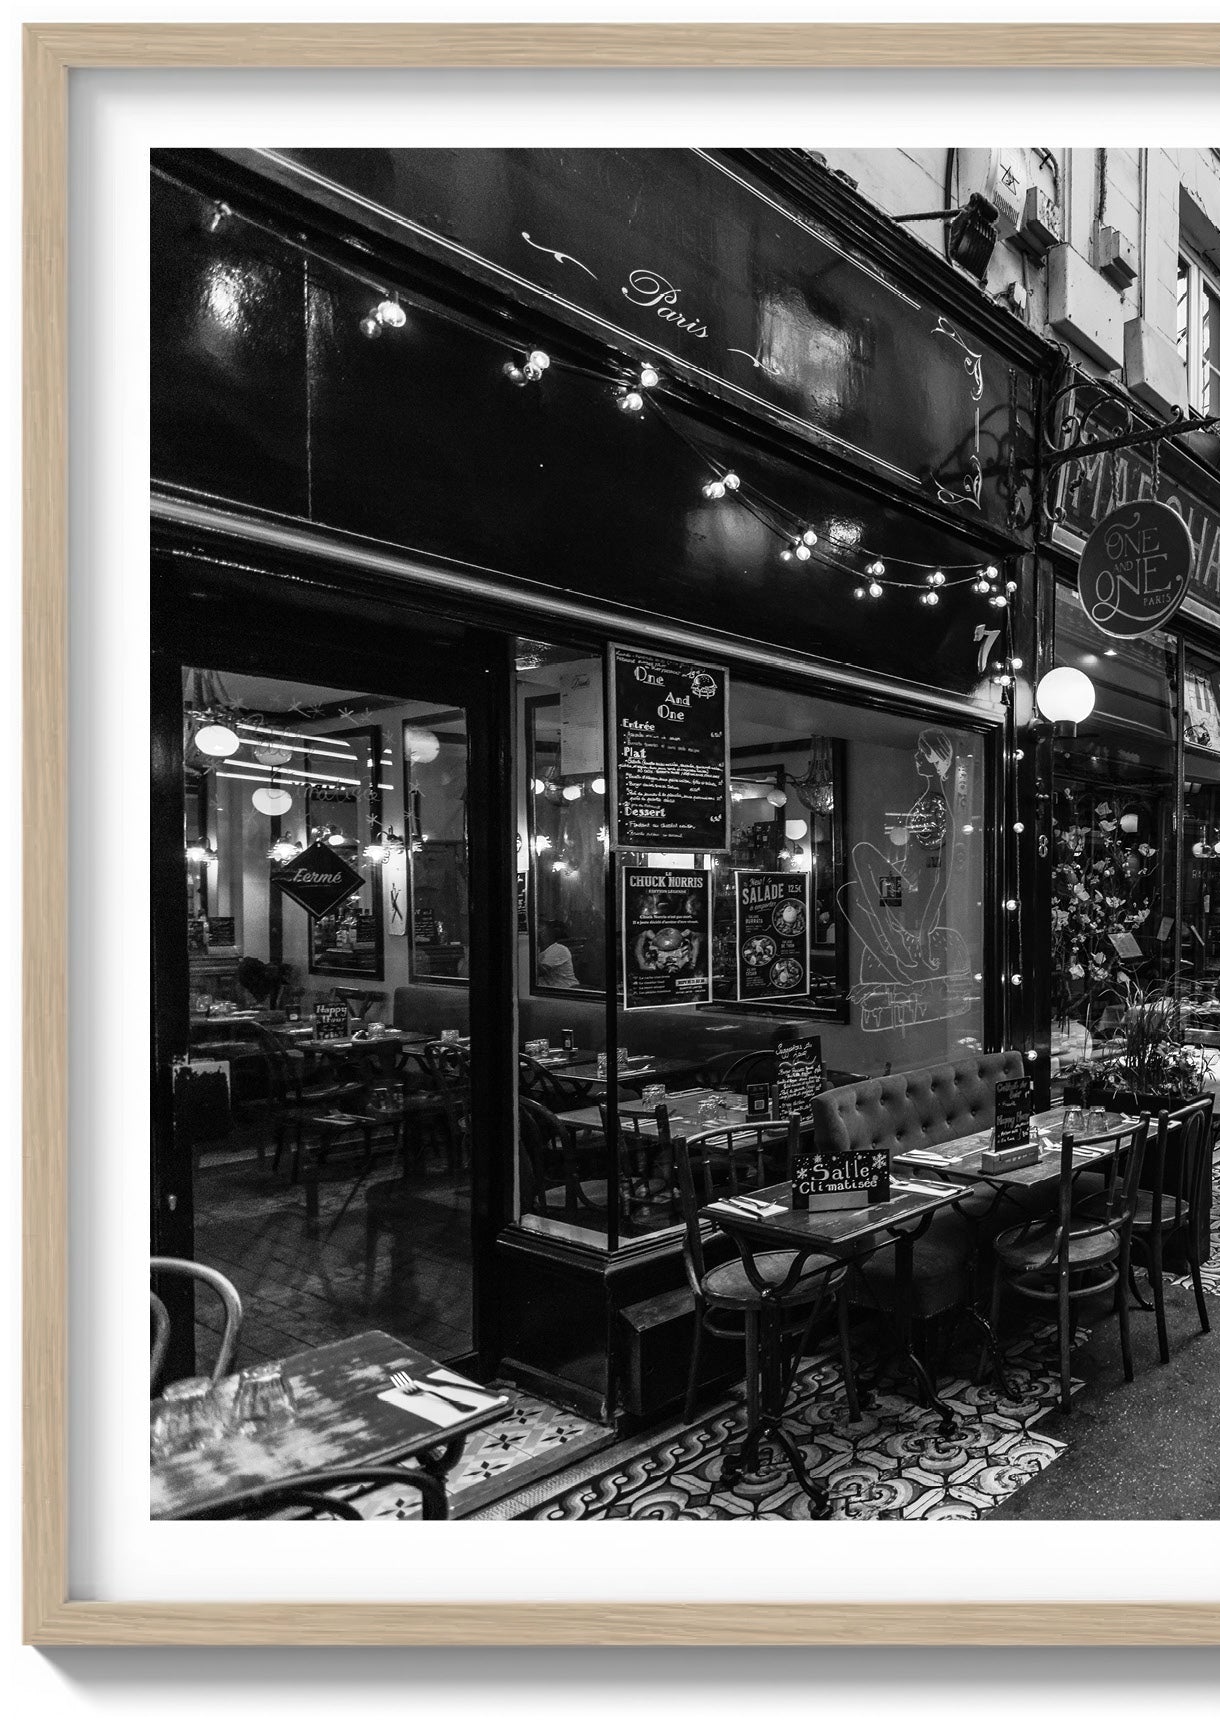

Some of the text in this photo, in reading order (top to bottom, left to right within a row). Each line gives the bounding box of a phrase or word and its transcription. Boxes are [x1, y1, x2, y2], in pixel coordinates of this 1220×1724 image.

[621, 269, 708, 338] Paris
[1104, 512, 1160, 560] ONE
[1113, 560, 1134, 574] AND
[1143, 592, 1172, 606] PARIS
[973, 623, 1001, 673] 7
[634, 666, 664, 685] One
[664, 692, 691, 706] And
[657, 704, 685, 721] One
[622, 718, 655, 731] Entrée
[623, 746, 647, 759] Plat
[624, 806, 667, 817] Dessert
[630, 876, 703, 888] CHUCK NORRIS
[742, 883, 784, 905] SALADE
[811, 1160, 869, 1181] Salle
[800, 1178, 877, 1194] Climatisée
